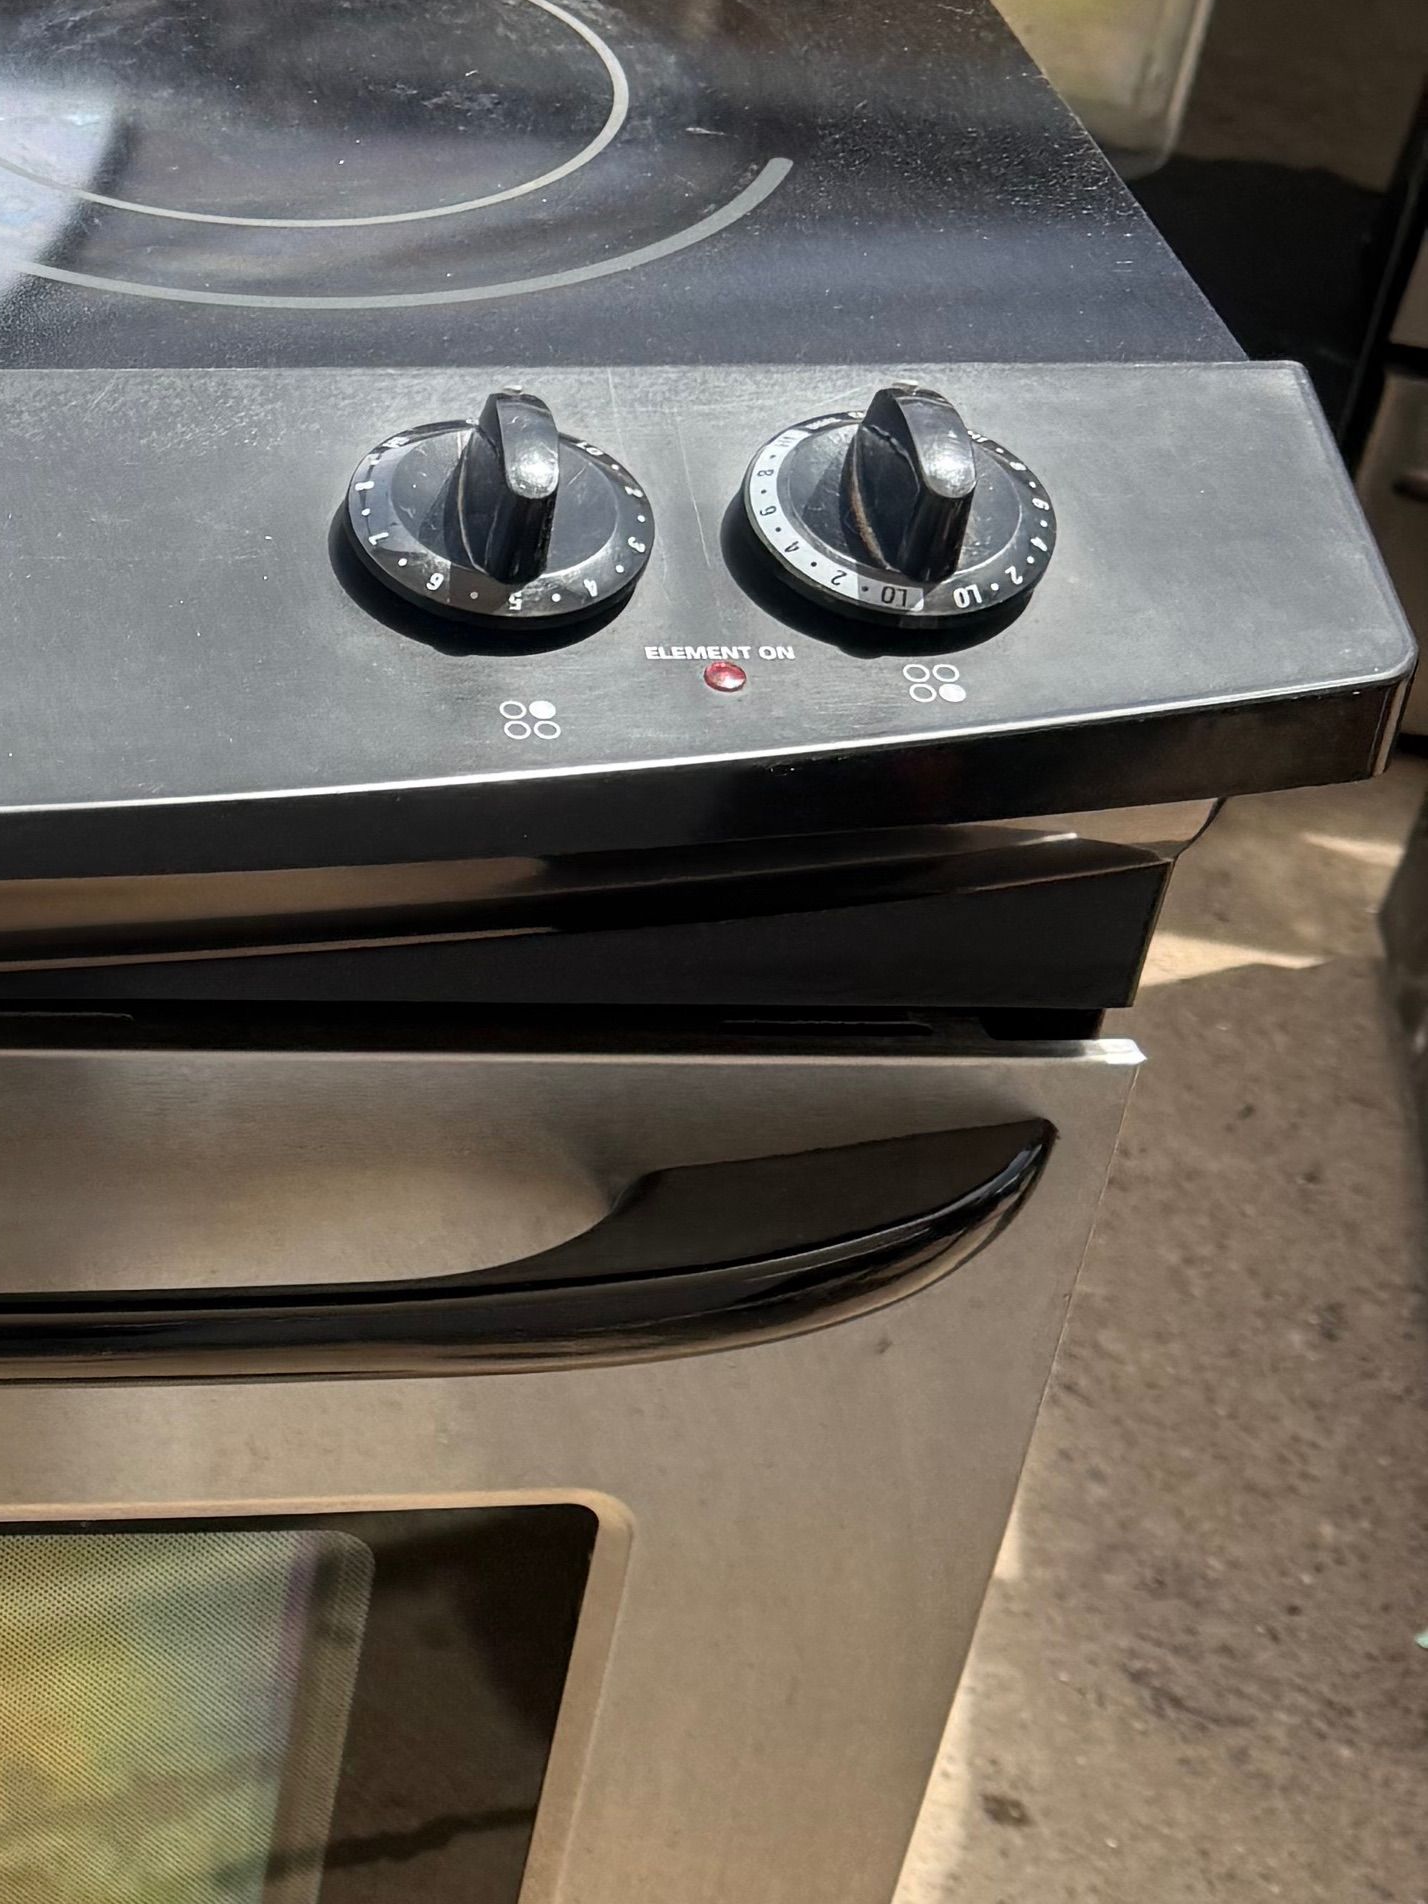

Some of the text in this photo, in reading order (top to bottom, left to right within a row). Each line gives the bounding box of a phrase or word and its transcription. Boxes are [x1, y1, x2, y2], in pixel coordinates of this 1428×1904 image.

[757, 468, 775, 478] 8
[758, 504, 778, 517] 6
[783, 539, 801, 554] 4
[425, 572, 445, 592] 6
[830, 568, 849, 587] 2
[1003, 565, 1025, 585] 2
[582, 577, 599, 597] 4
[880, 584, 909, 608] LO
[953, 583, 984, 610] LO
[508, 590, 524, 611] 5
[644, 645, 796, 660] ELEMENT ON
